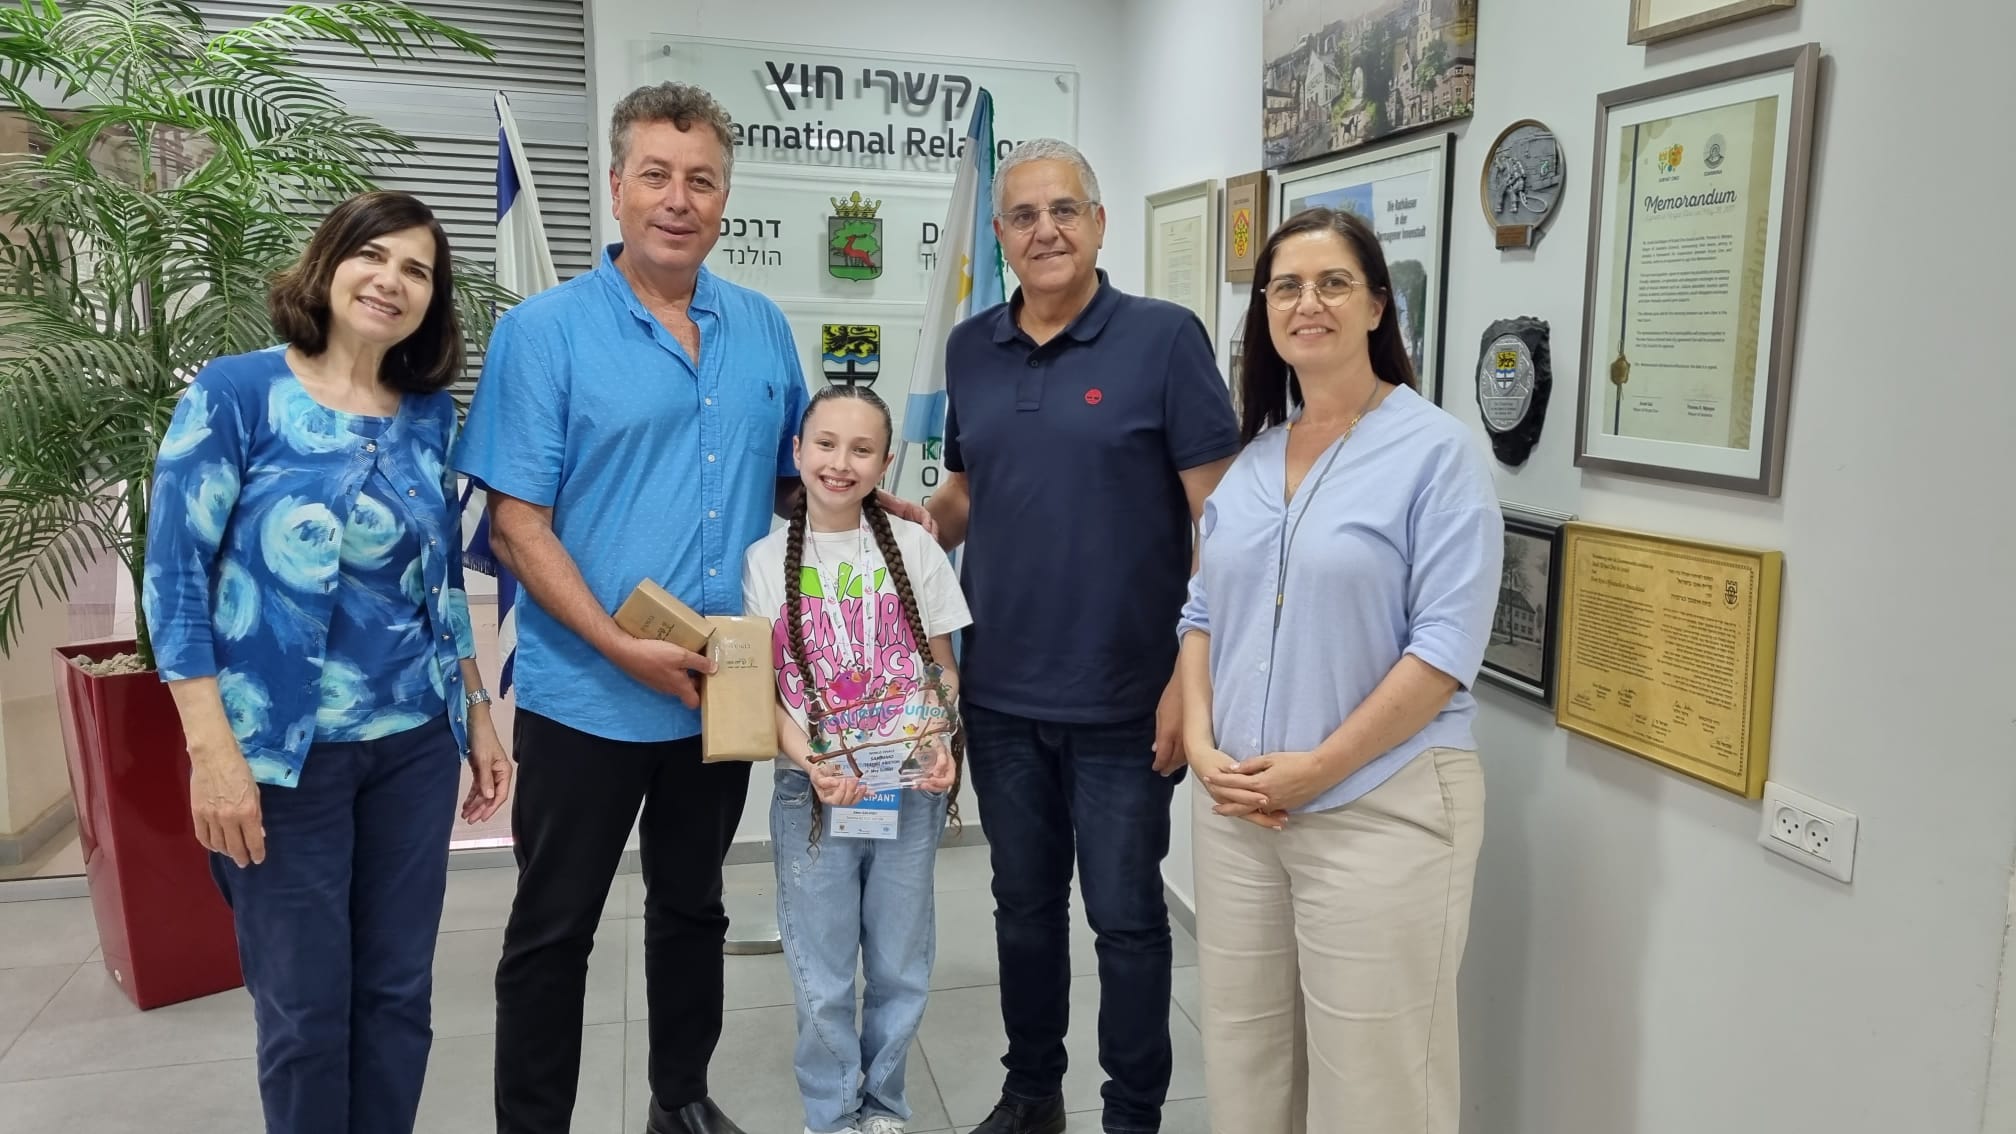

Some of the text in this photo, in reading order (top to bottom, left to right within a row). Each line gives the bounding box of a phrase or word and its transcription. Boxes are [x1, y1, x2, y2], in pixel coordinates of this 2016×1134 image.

[765, 61, 972, 121] קשרי חוץ
[732, 120, 895, 155] ernational
[1644, 188, 1738, 214] Memorandum
[722, 245, 782, 266] הולנד
[863, 793, 896, 803] CIPANT
